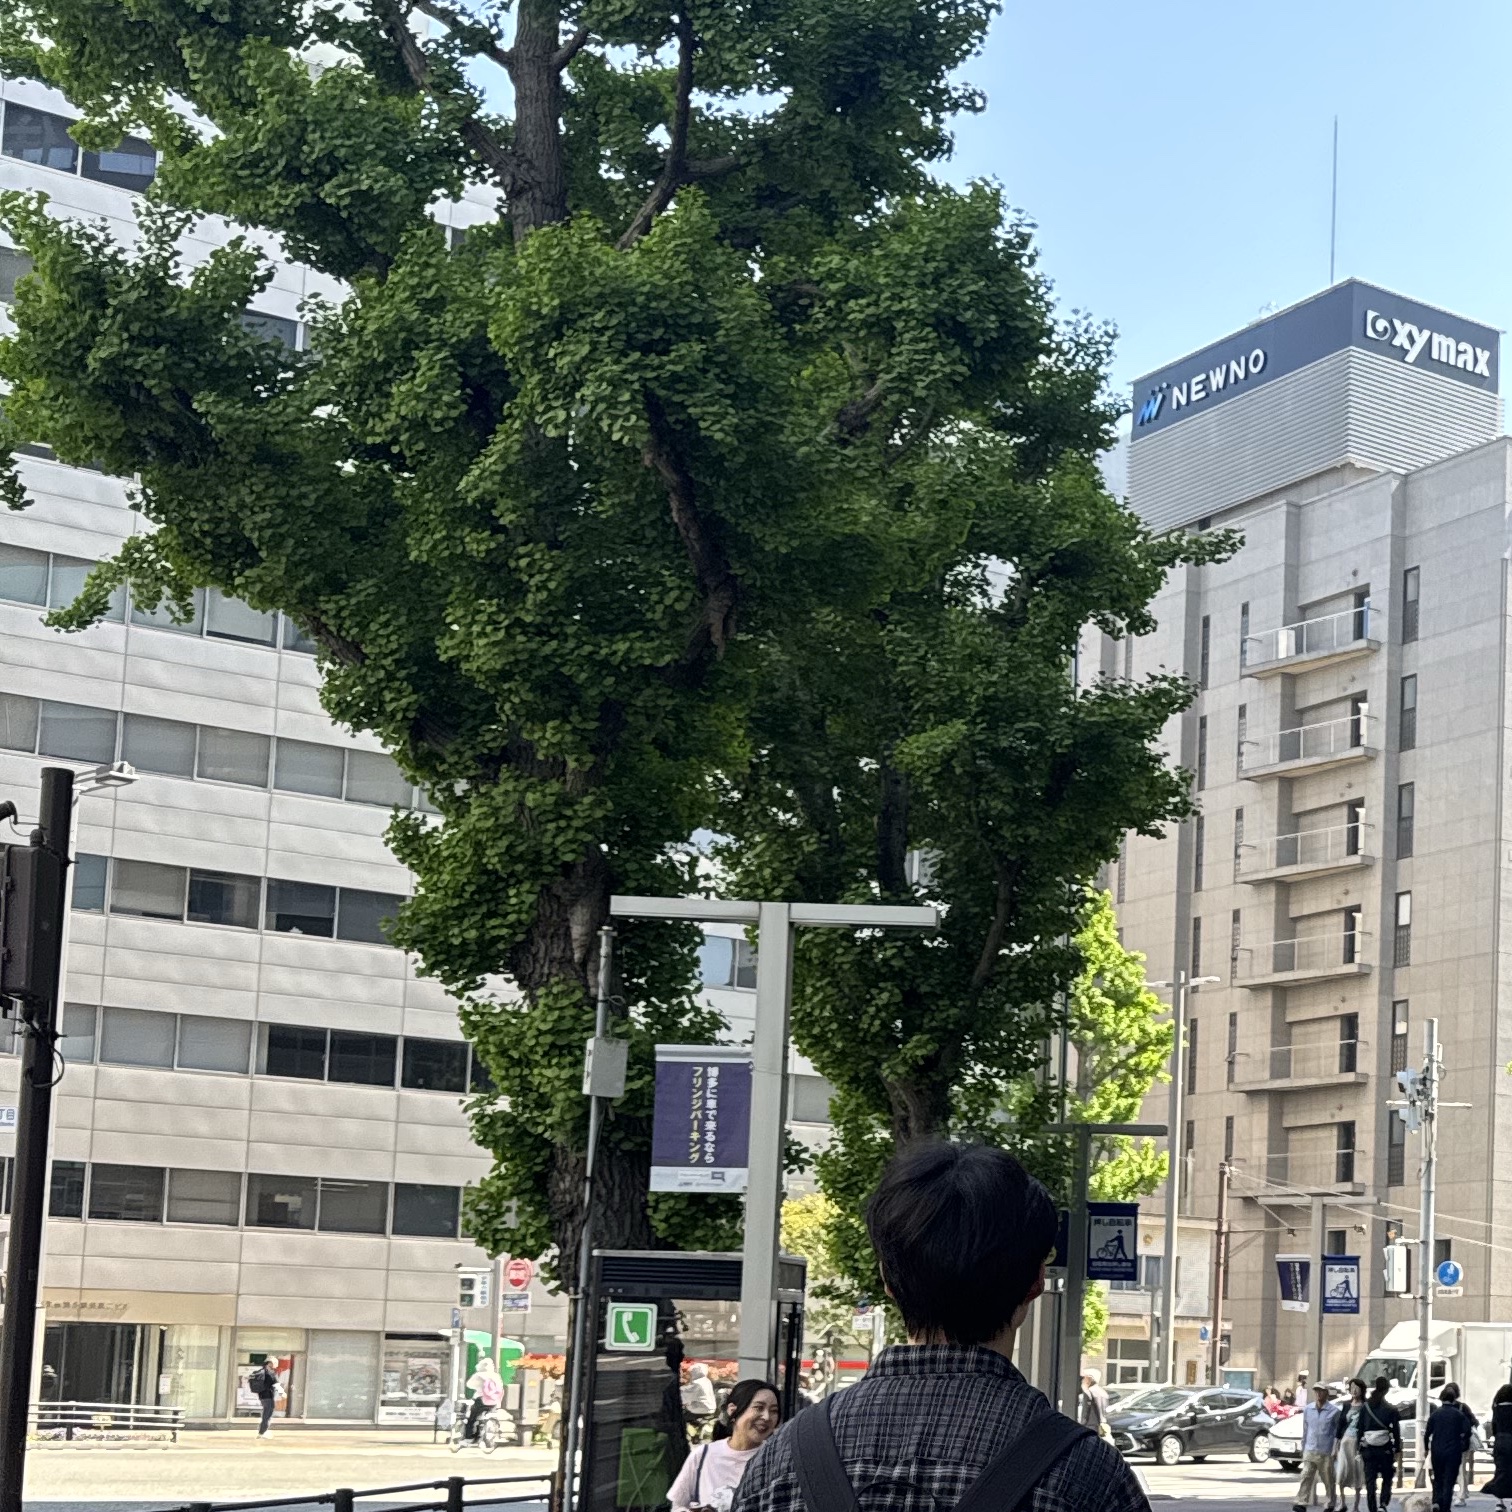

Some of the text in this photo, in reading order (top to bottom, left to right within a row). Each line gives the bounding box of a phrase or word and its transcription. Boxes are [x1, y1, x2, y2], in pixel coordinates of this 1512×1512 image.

[1170, 347, 1267, 410] NEWNO
[688, 1066, 704, 1164] フリンジパーキング
